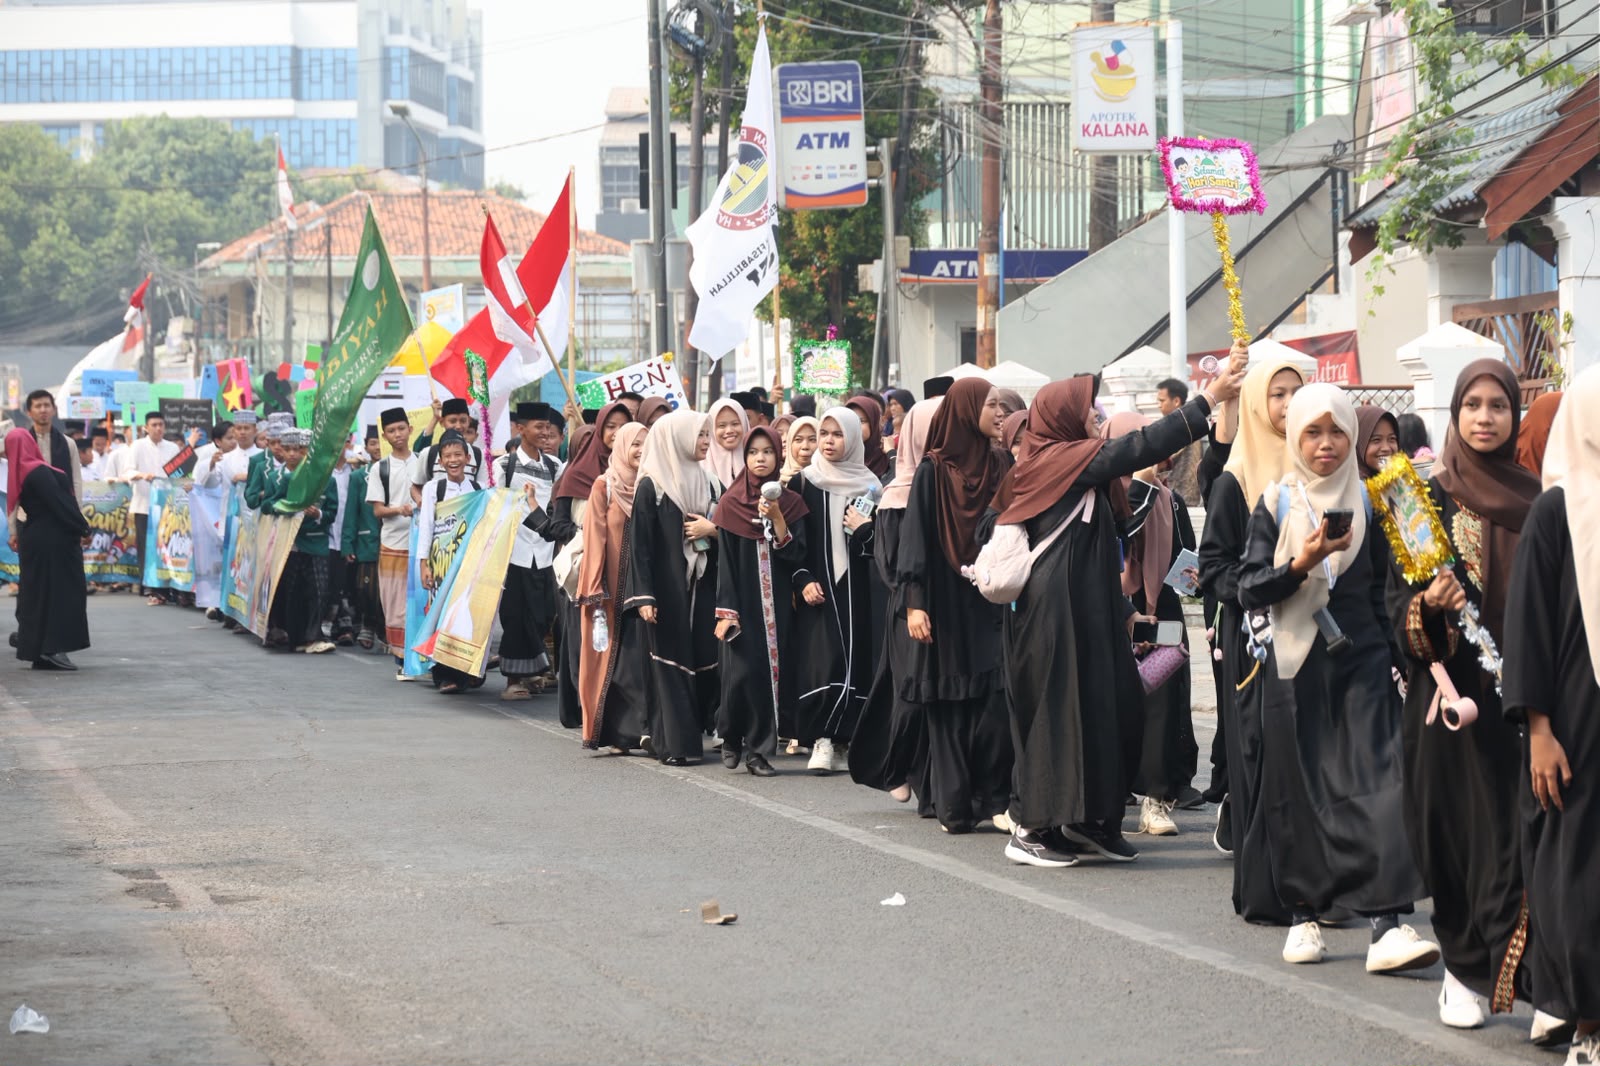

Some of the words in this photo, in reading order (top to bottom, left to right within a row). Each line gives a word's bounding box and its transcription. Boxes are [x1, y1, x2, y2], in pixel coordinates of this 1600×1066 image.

[813, 79, 853, 104] BRI
[1089, 111, 1137, 122] APOTEK
[1081, 122, 1149, 137] KALANA
[795, 131, 850, 150] ATM
[1193, 166, 1225, 177] Selamat
[1186, 175, 1207, 190] Hari
[1208, 175, 1239, 190] Santri
